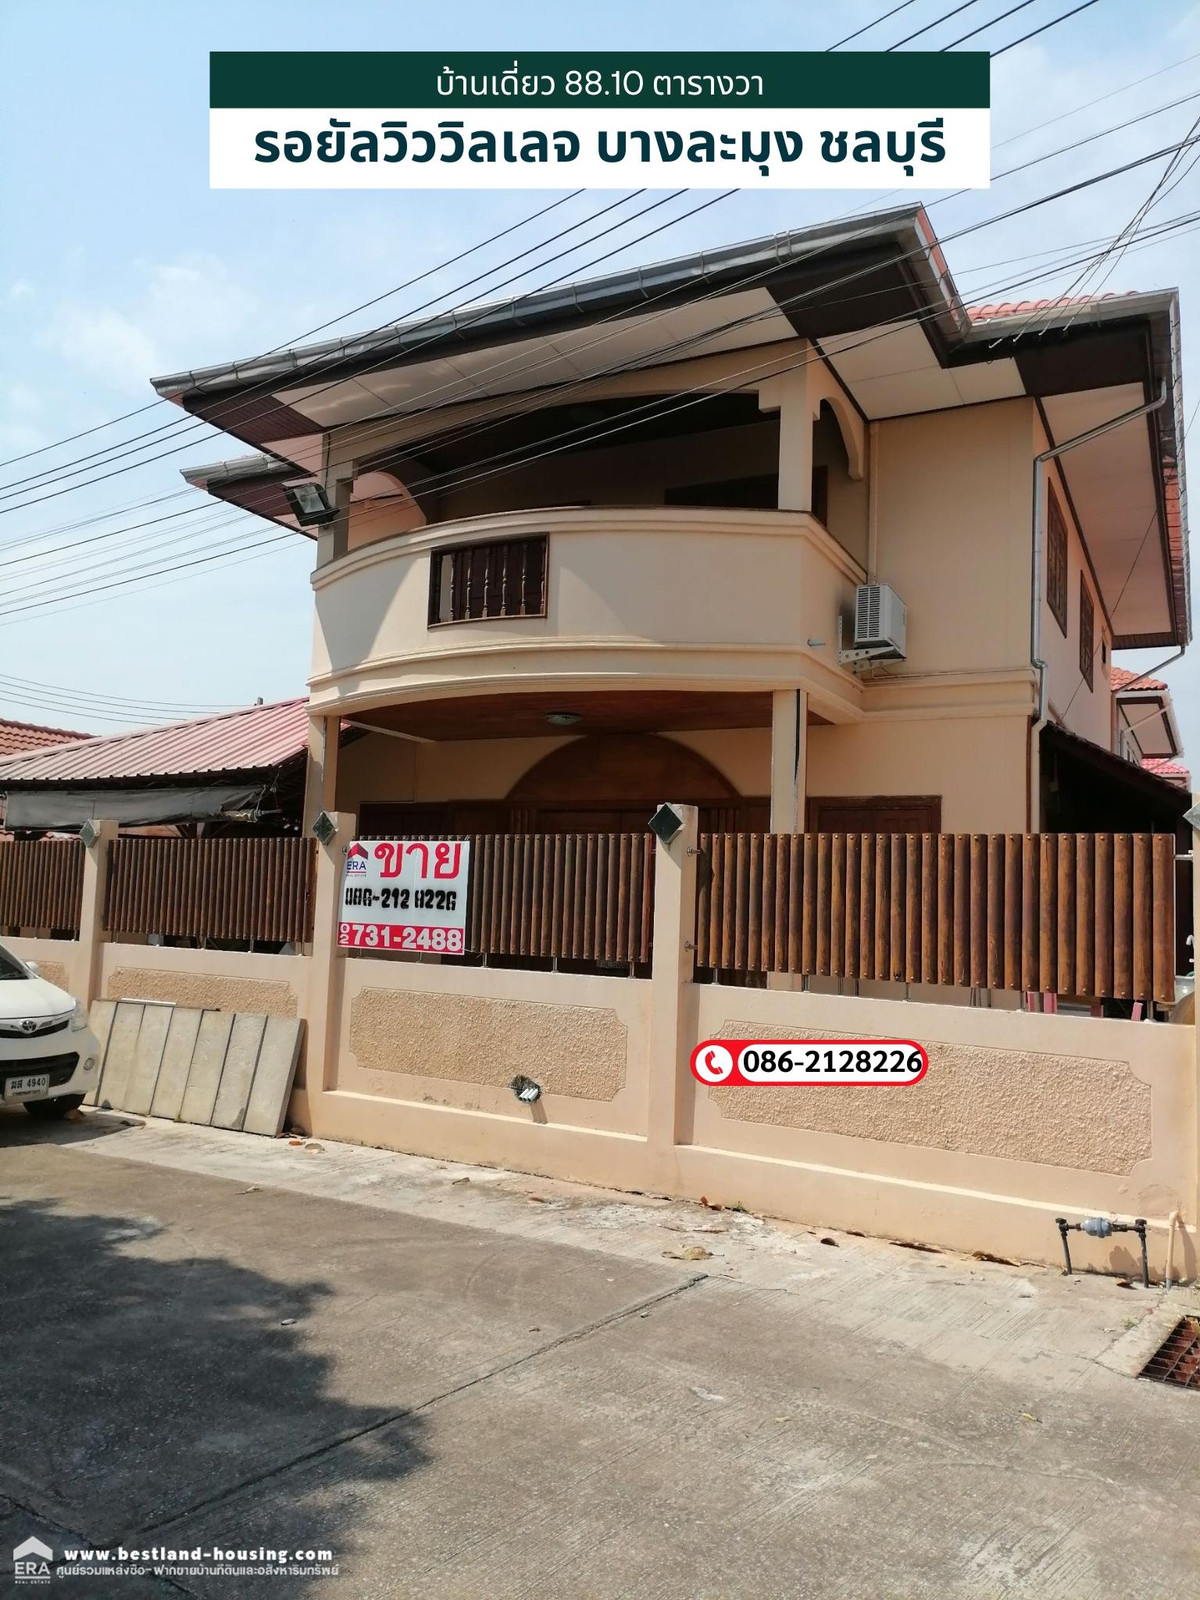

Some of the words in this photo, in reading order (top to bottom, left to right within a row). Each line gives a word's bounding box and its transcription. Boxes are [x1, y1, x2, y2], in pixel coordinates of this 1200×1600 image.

[346, 861, 367, 870] ERA
[374, 843, 461, 879] ขาย
[352, 925, 462, 951] 731-2488
